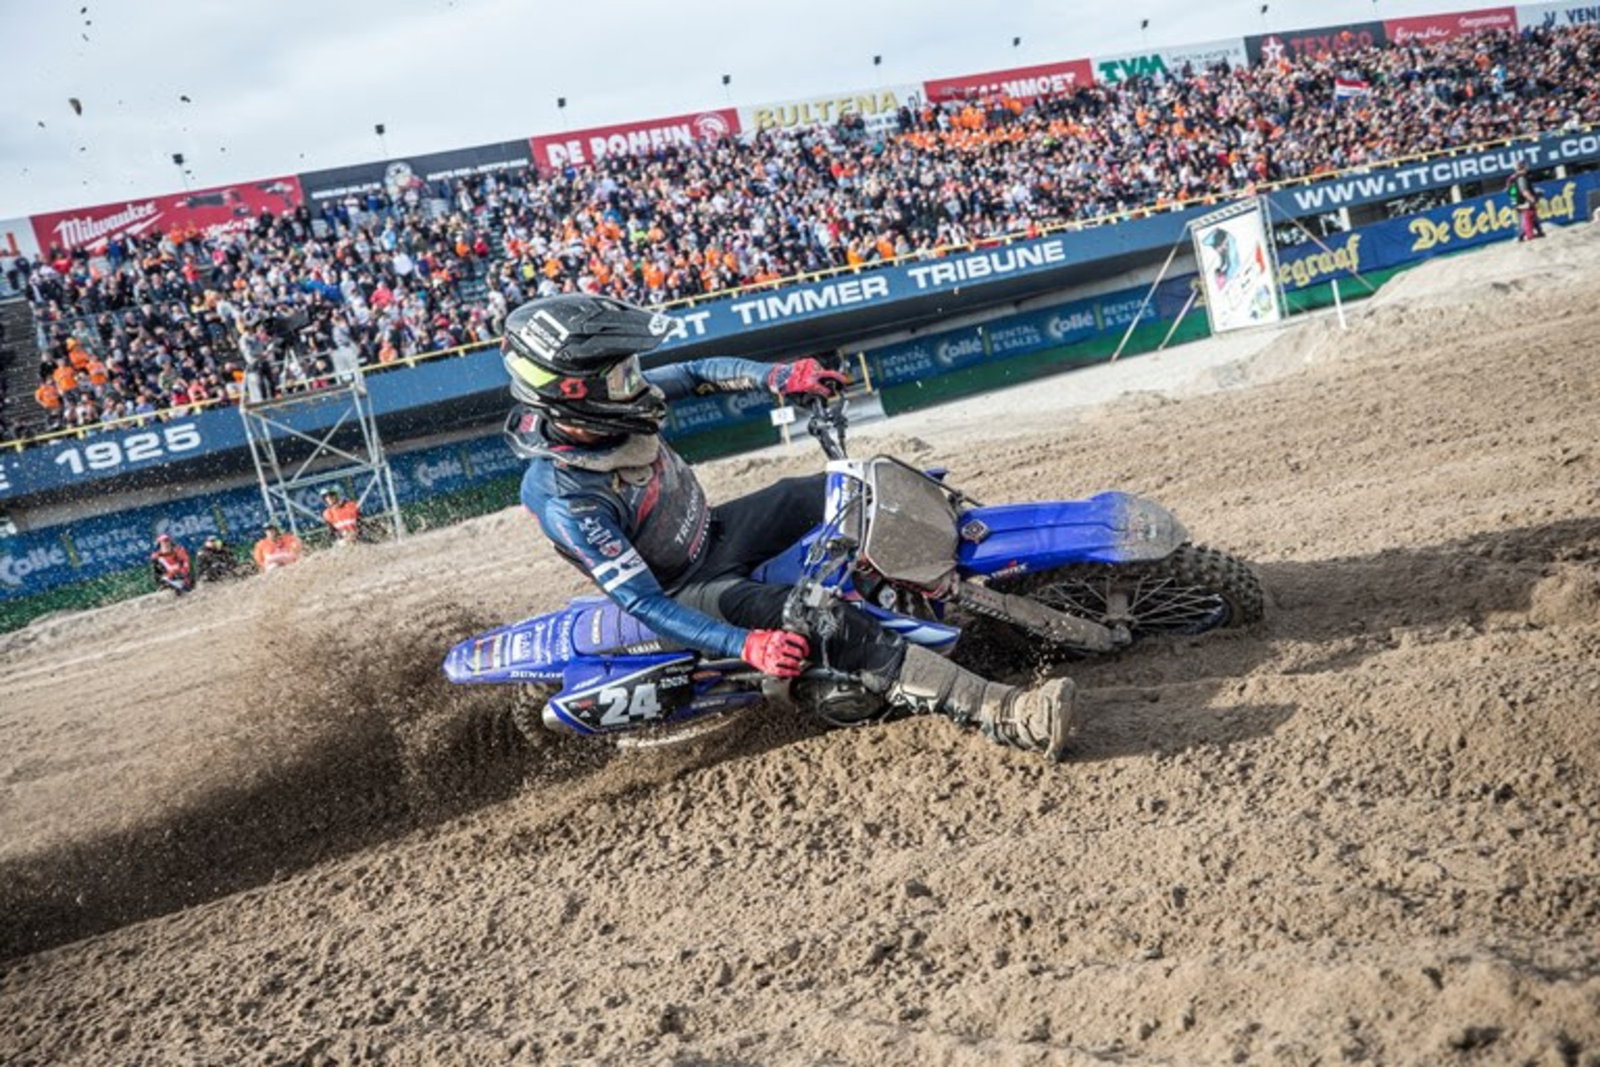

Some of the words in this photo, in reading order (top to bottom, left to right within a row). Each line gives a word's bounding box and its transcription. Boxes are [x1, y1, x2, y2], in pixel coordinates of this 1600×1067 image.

[1565, 6, 1600, 23] VEN
[964, 72, 1075, 98] MMOET
[1099, 54, 1168, 82] TVM
[752, 92, 899, 129] BULTENA
[546, 140, 585, 167] DE
[1294, 136, 1600, 210] WWW.TTCIRCUIT.CO
[53, 201, 157, 250] Milwaukee
[1408, 217, 1450, 252] De
[1453, 181, 1576, 239] Teleaaf
[732, 276, 889, 326] TIMMER
[908, 240, 1066, 289] TRIBUNE
[991, 324, 1036, 341] RENTAL
[54, 423, 201, 474] 1925
[510, 670, 564, 678] DUNLOP
[599, 683, 662, 726] 24
